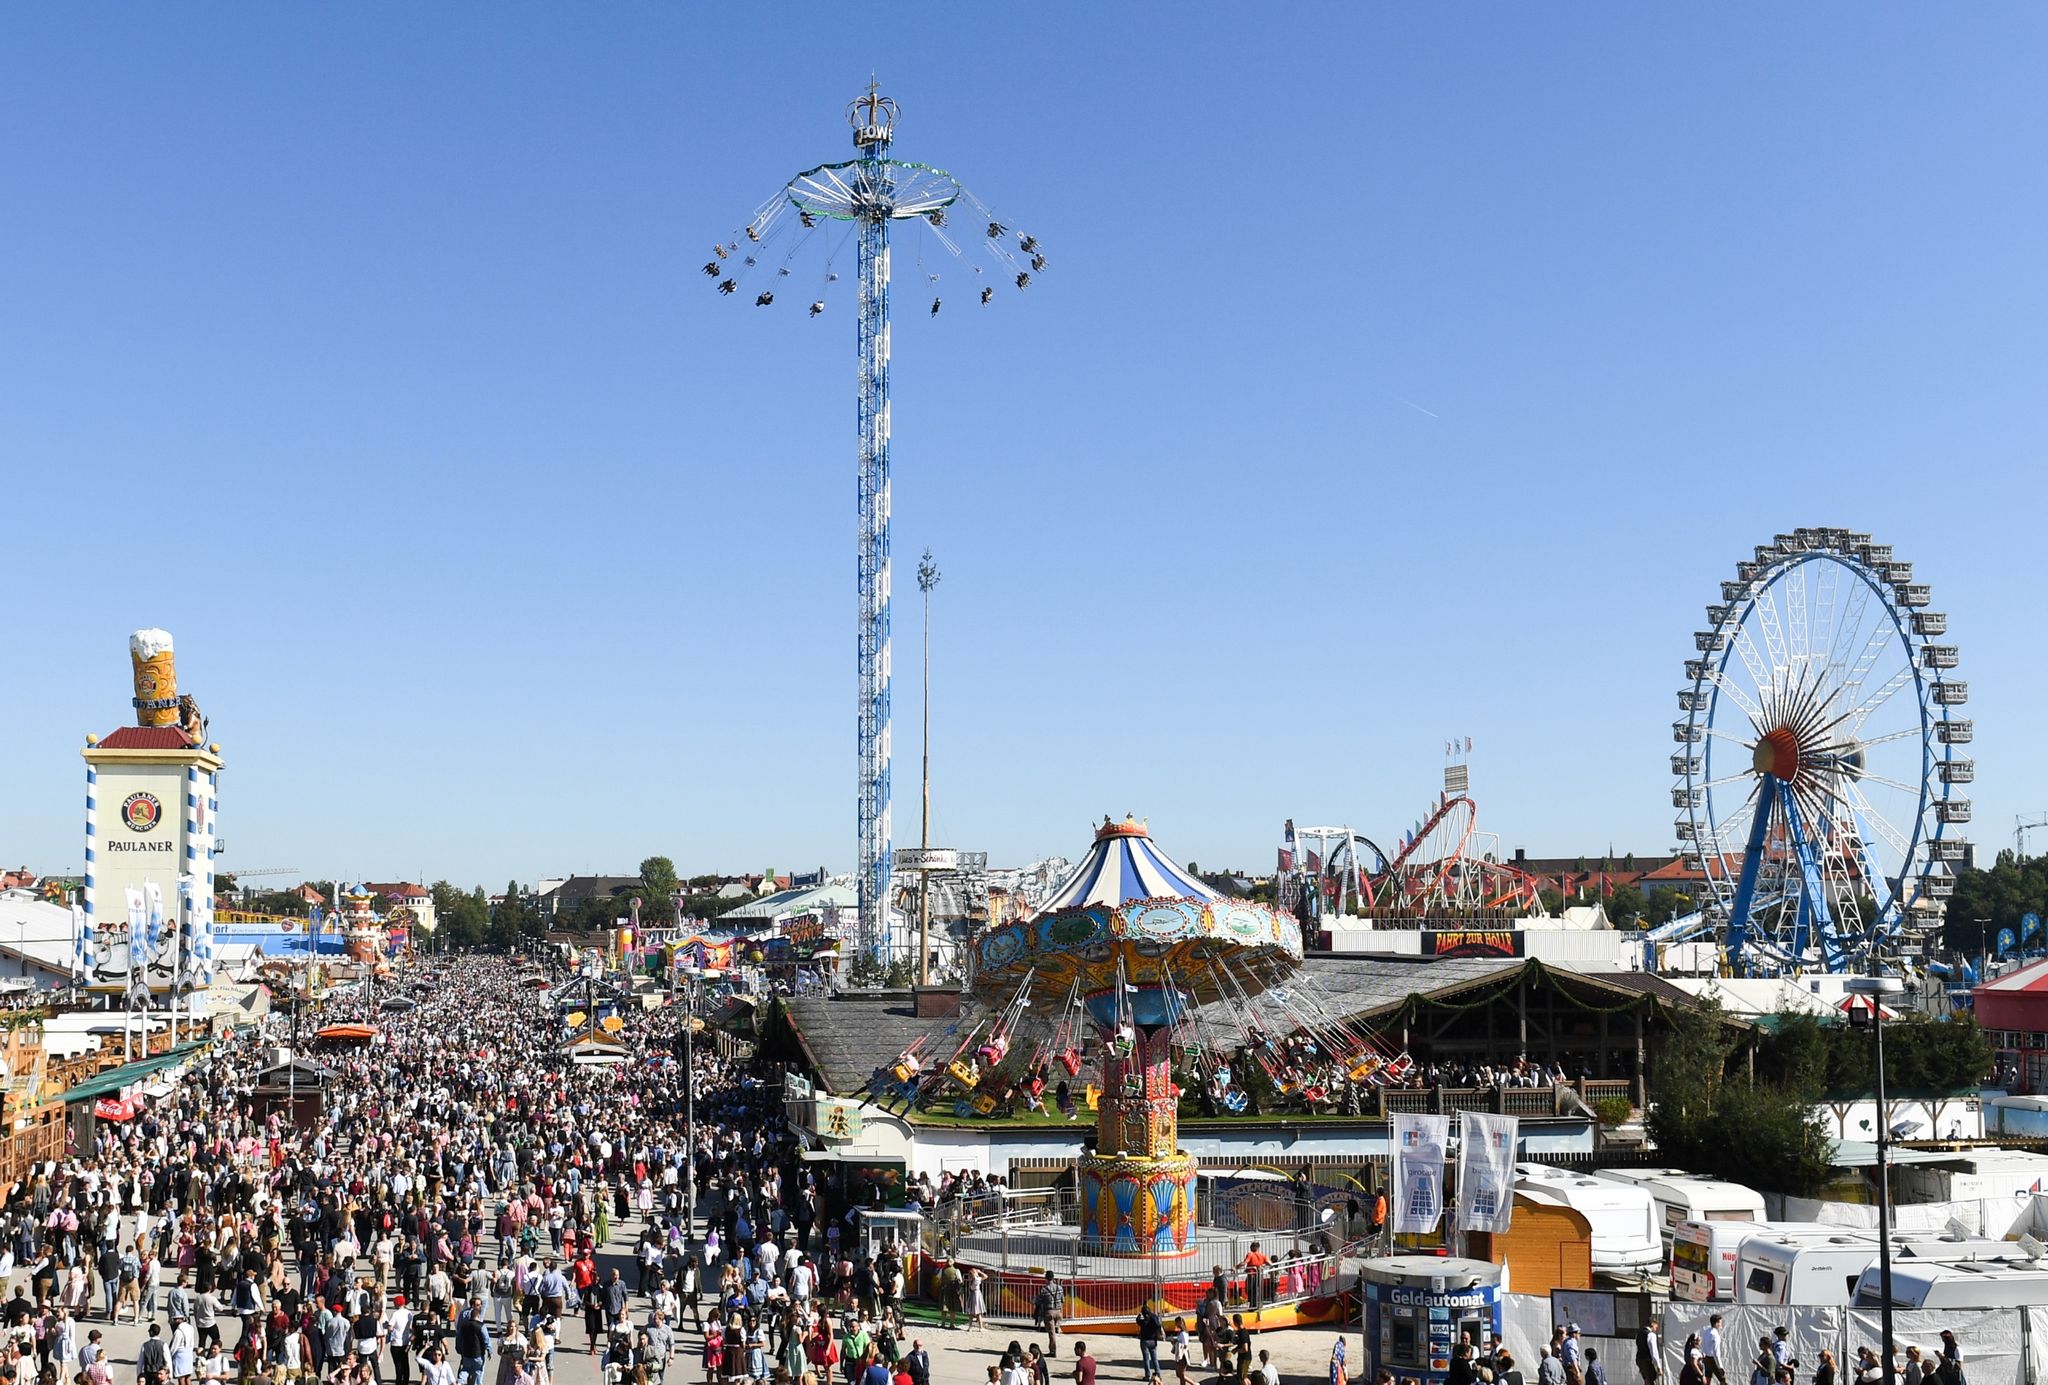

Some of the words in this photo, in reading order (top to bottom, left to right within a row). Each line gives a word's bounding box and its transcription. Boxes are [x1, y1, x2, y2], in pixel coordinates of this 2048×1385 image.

[123, 792, 160, 807] PAULANER
[108, 840, 174, 852] PAULANER
[1434, 932, 1465, 956] FAHRT
[1466, 932, 1484, 945] ZUR
[1391, 1289, 1485, 1308] Geldautomat
[1432, 1325, 1449, 1333] VISA
